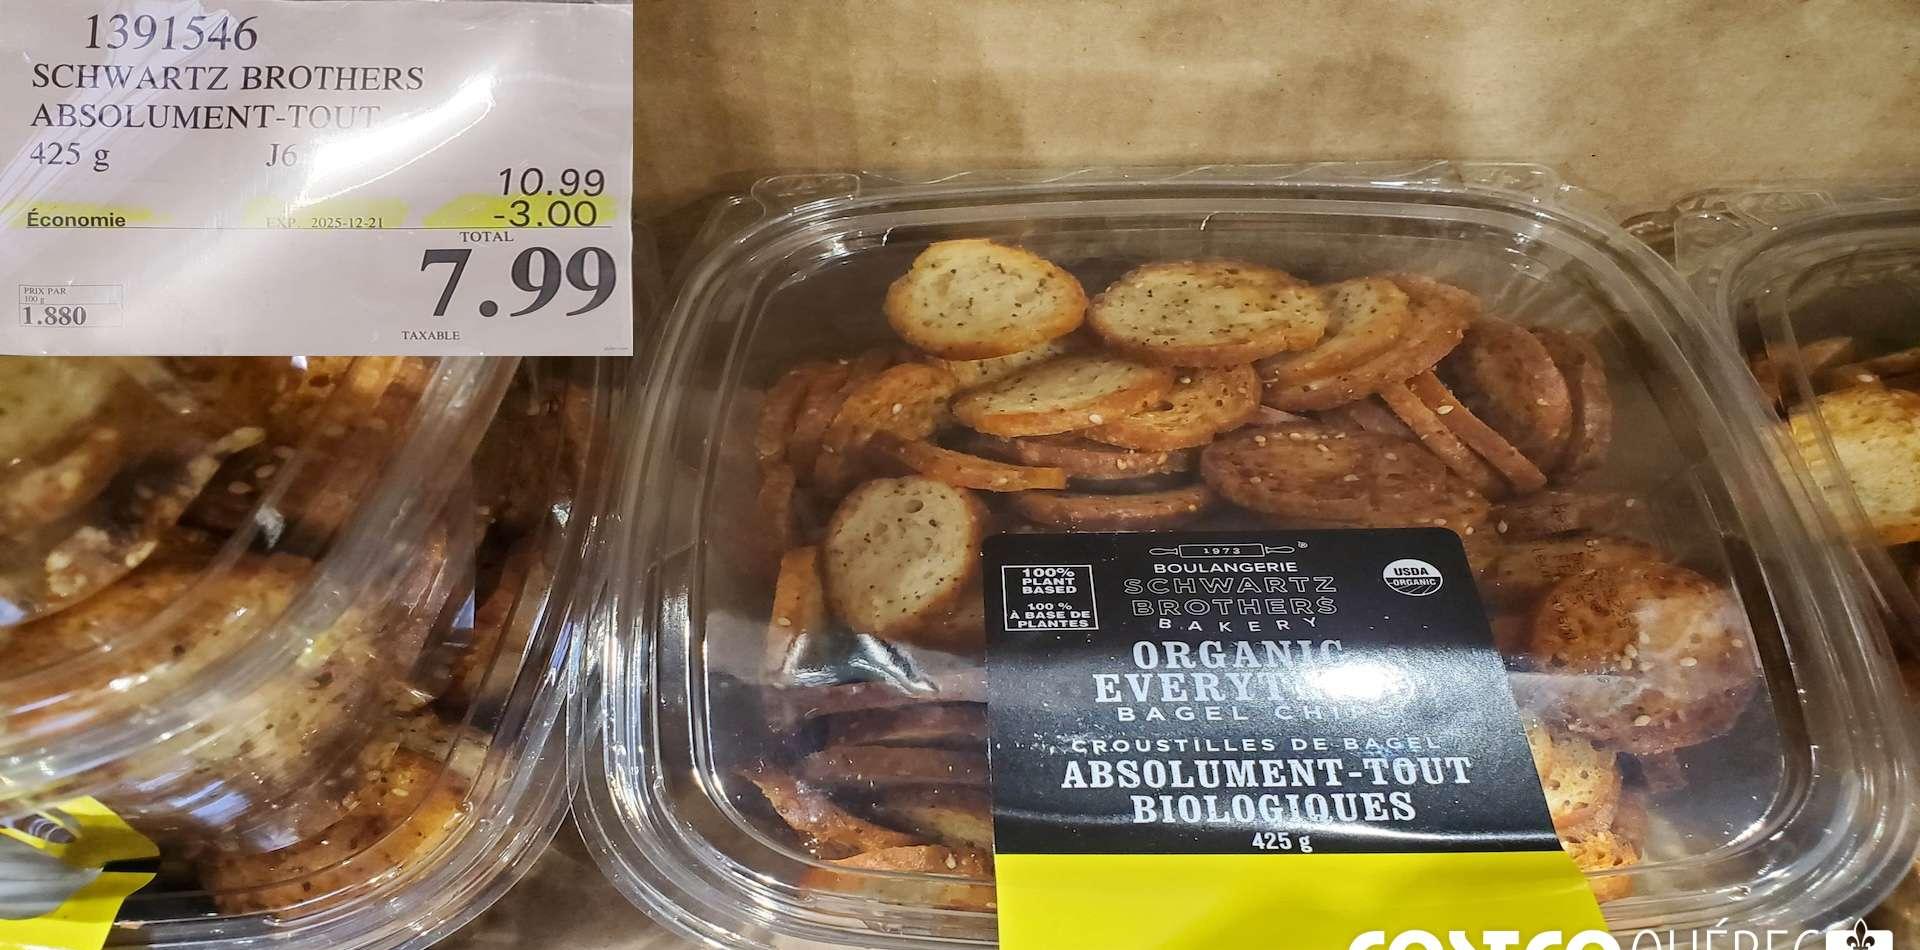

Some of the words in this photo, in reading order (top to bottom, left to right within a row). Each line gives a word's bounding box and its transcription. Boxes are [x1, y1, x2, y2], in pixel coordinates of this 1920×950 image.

[85, 14, 258, 51] 1391546
[32, 63, 229, 91] SCHWARTZ
[240, 65, 425, 91] BROTHERS
[30, 103, 381, 129] ABSOLUMENT-TOUT
[30, 142, 81, 165] 425
[92, 149, 110, 172] g
[499, 167, 605, 197] 10.99
[27, 208, 126, 227] Économie
[311, 217, 384, 229] 2025-12-21
[494, 200, 597, 227] -3.00
[460, 231, 514, 243] TOTAL
[24, 287, 45, 295] PRIX
[48, 287, 66, 295] PAR
[421, 246, 617, 318] 7.99
[23, 306, 87, 326] 1.880
[402, 331, 460, 340] TAXABLE
[1022, 568, 1075, 577] 100%
[1153, 562, 1298, 574] BOULANGERIE
[1393, 567, 1429, 576] USDA
[1022, 586, 1077, 594] BASED
[1124, 576, 1337, 594] SCHWARTZ
[1392, 578, 1436, 586] ORGANIC
[1010, 610, 1020, 619] À
[1025, 611, 1065, 619] BASE
[1070, 611, 1091, 619] DE
[1027, 602, 1054, 610] 100
[1057, 602, 1073, 610] %
[1132, 597, 1338, 616] BROTHERS
[1018, 620, 1089, 628] PLANTES
[1133, 640, 1344, 669] ORGANIC
[1117, 706, 1249, 721] BAGEL
[1071, 737, 1276, 754] CROUSTILLES
[1291, 737, 1327, 750] DE
[1346, 736, 1440, 751] BAGEL
[1061, 757, 1472, 789] ABSOLUMENT-TOUT
[1132, 791, 1416, 825] BIOLOGIQUES
[1252, 832, 1292, 850] 425
[1298, 837, 1313, 854] g
